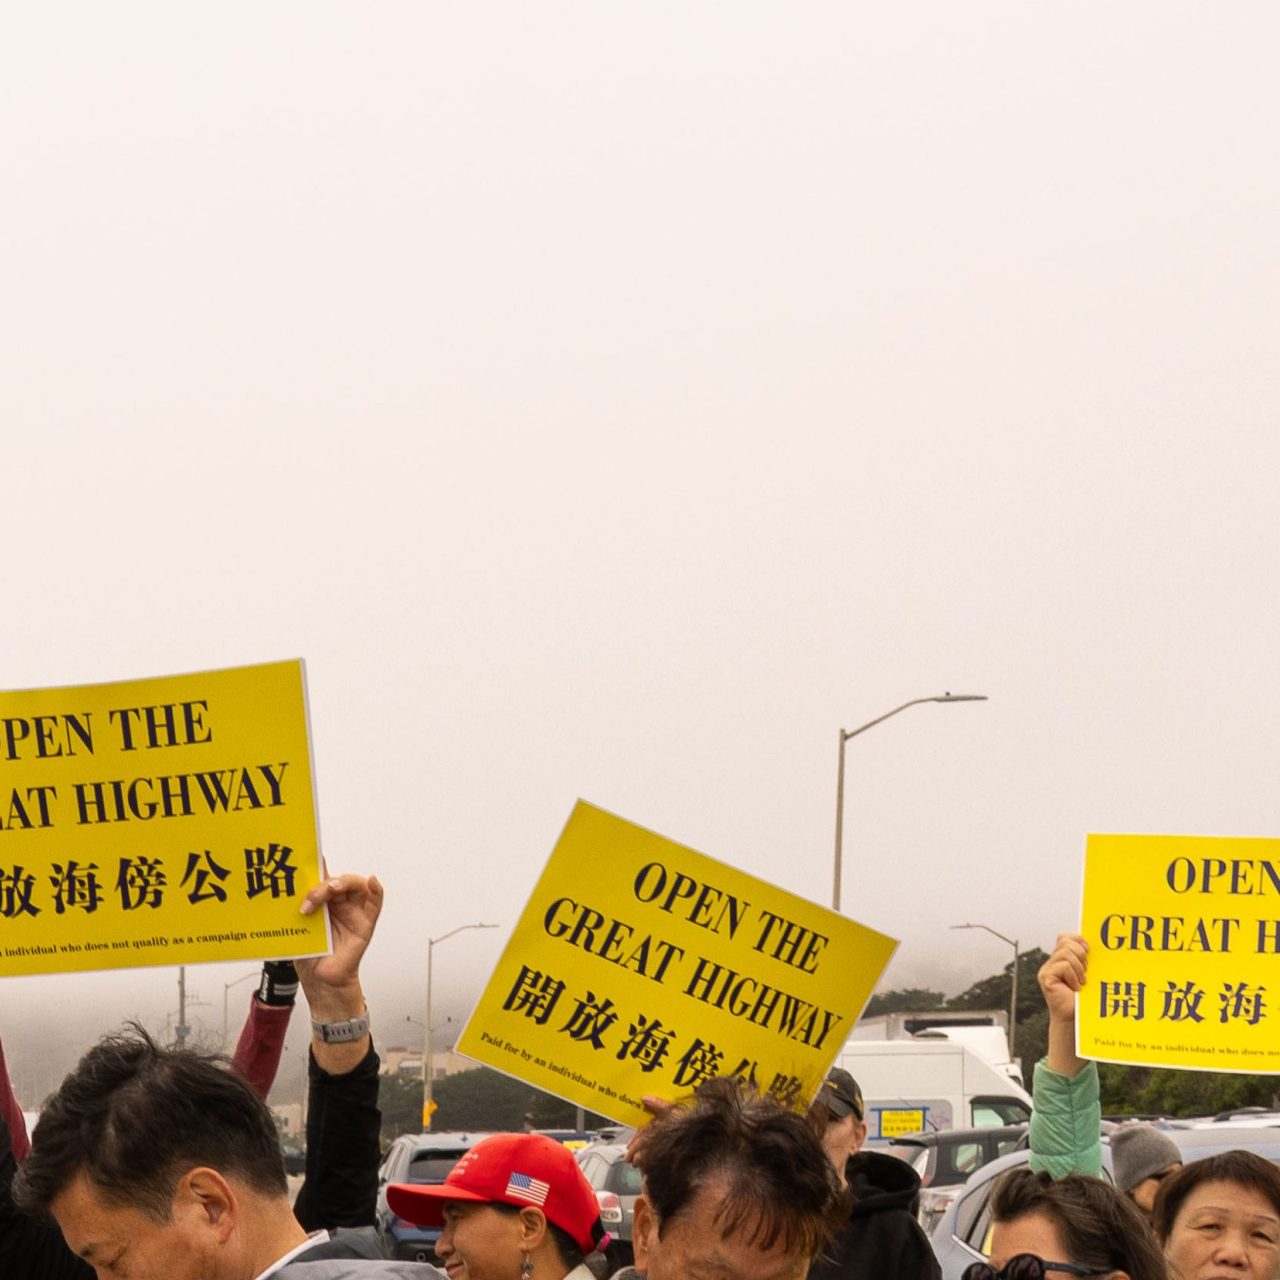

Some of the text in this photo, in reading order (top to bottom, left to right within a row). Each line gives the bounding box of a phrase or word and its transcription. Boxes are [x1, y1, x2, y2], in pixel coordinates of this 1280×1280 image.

[109, 700, 212, 751] THE
[73, 763, 288, 824] HIGHWAY
[634, 863, 829, 974] OPEN THE
[1100, 915, 1239, 952] GREAT
[544, 898, 843, 1049] GREAT HIGHWAY
